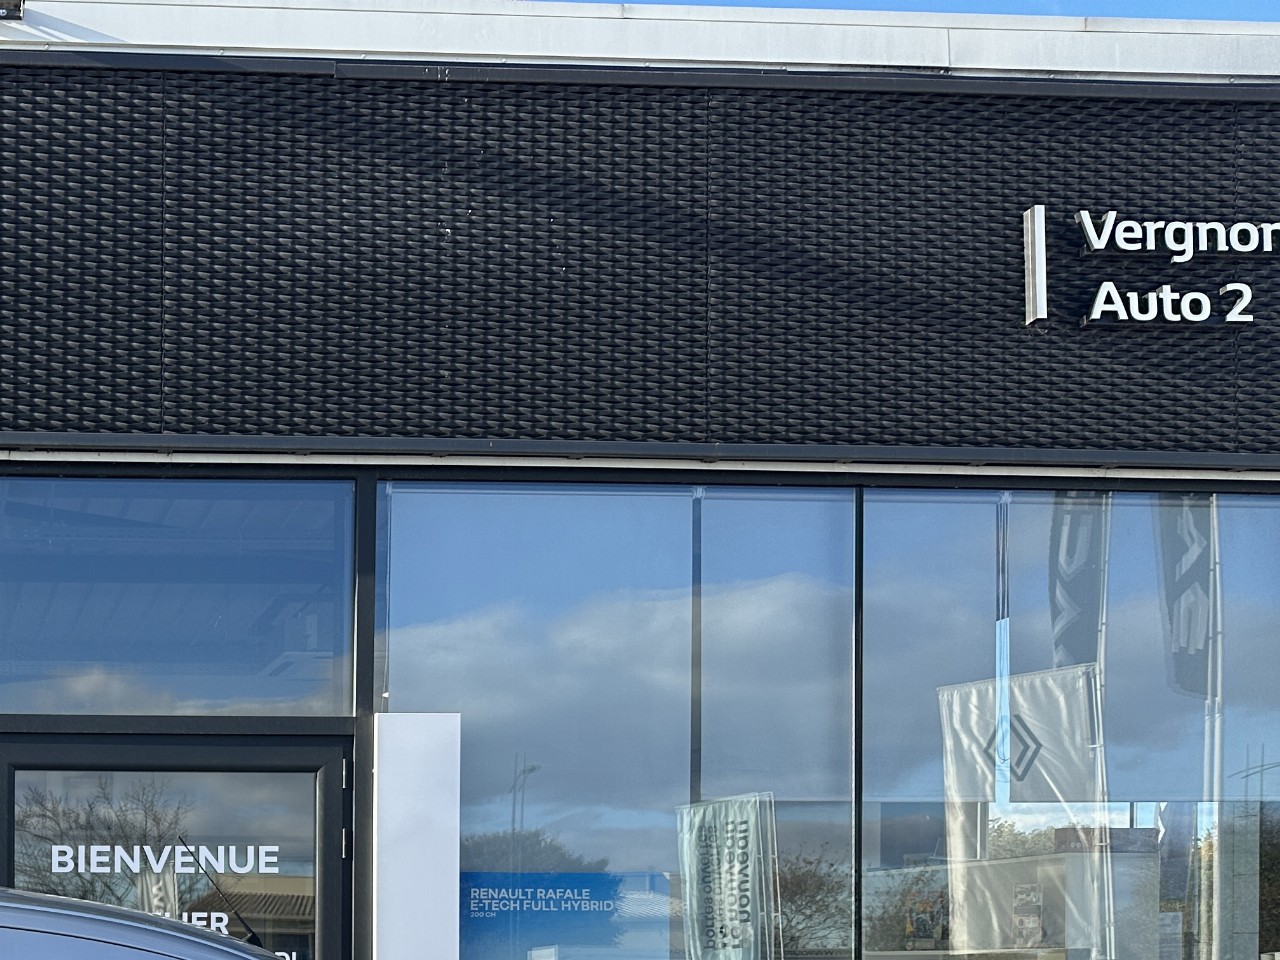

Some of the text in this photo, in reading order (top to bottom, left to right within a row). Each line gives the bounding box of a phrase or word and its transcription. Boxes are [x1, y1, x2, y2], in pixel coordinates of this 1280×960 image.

[1088, 281, 1254, 322] Auto 2
[51, 844, 279, 873] BIENVENUE
[470, 888, 591, 899] RENAULT RAFALE
[470, 900, 614, 911] E-TECH FULL HYBRID
